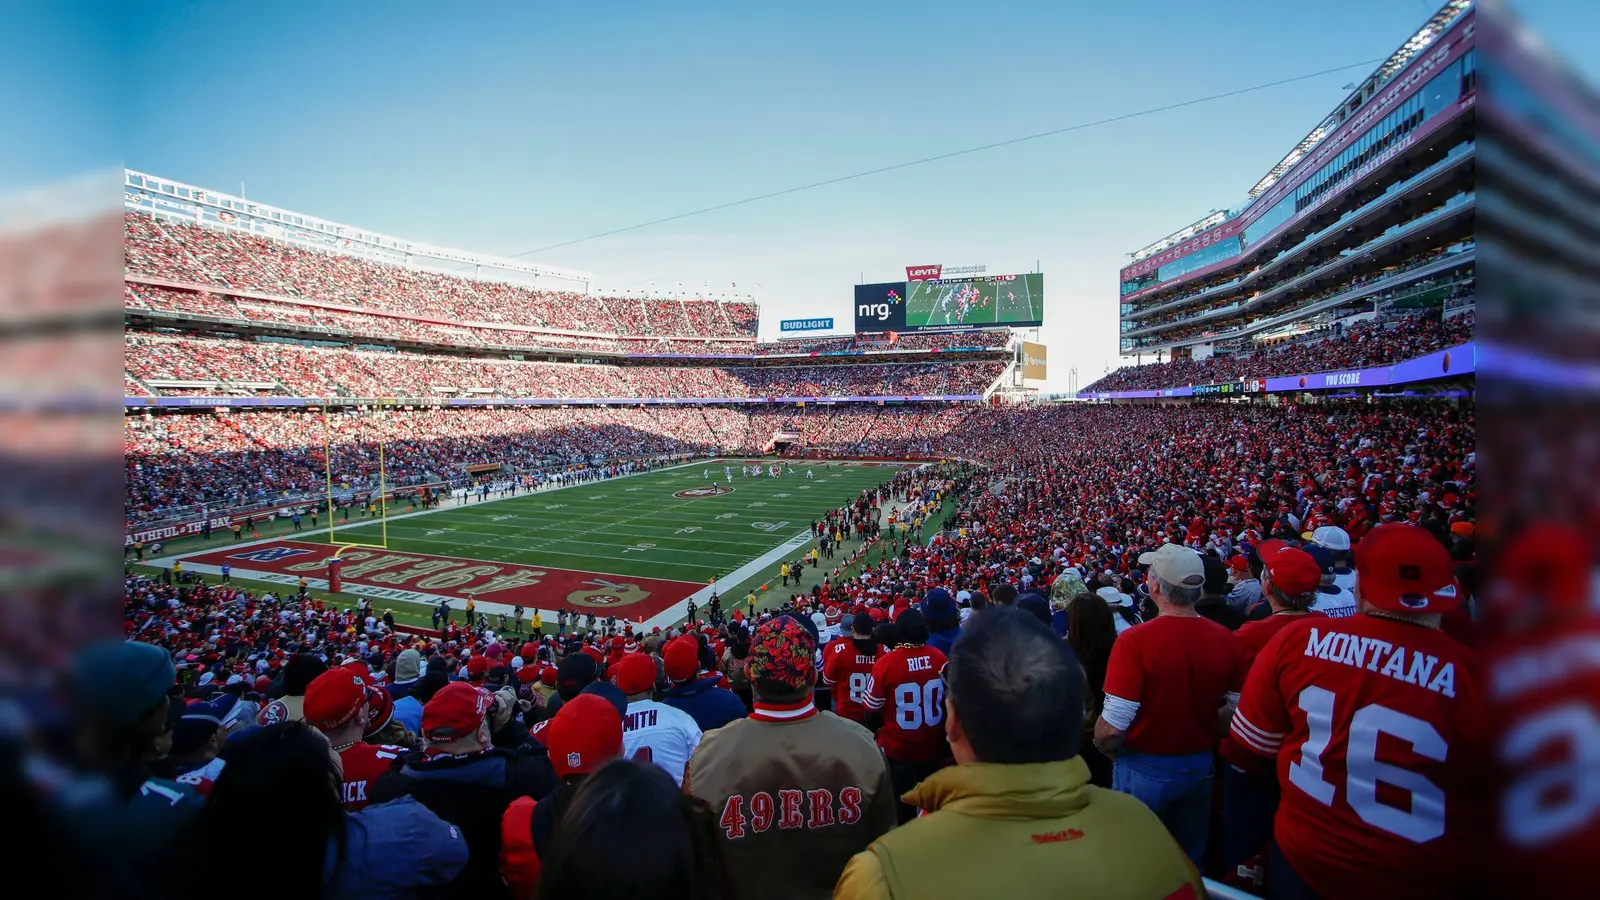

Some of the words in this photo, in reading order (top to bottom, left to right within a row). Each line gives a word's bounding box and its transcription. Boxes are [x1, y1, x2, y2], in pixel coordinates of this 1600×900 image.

[1357, 135, 1415, 178] FAITHFUL
[1325, 374, 1338, 386] YOU
[1338, 372, 1360, 385] SCORE
[125, 526, 180, 546] AITHFUL
[855, 654, 876, 665] KITTLE
[907, 655, 932, 672] RICE
[1304, 627, 1455, 699] MONTANA
[849, 672, 872, 704] 8
[894, 678, 944, 730] 80
[622, 709, 658, 732] MITH
[1288, 684, 1449, 844] 16
[343, 780, 367, 803] ICK
[720, 786, 862, 840] 49ERS
